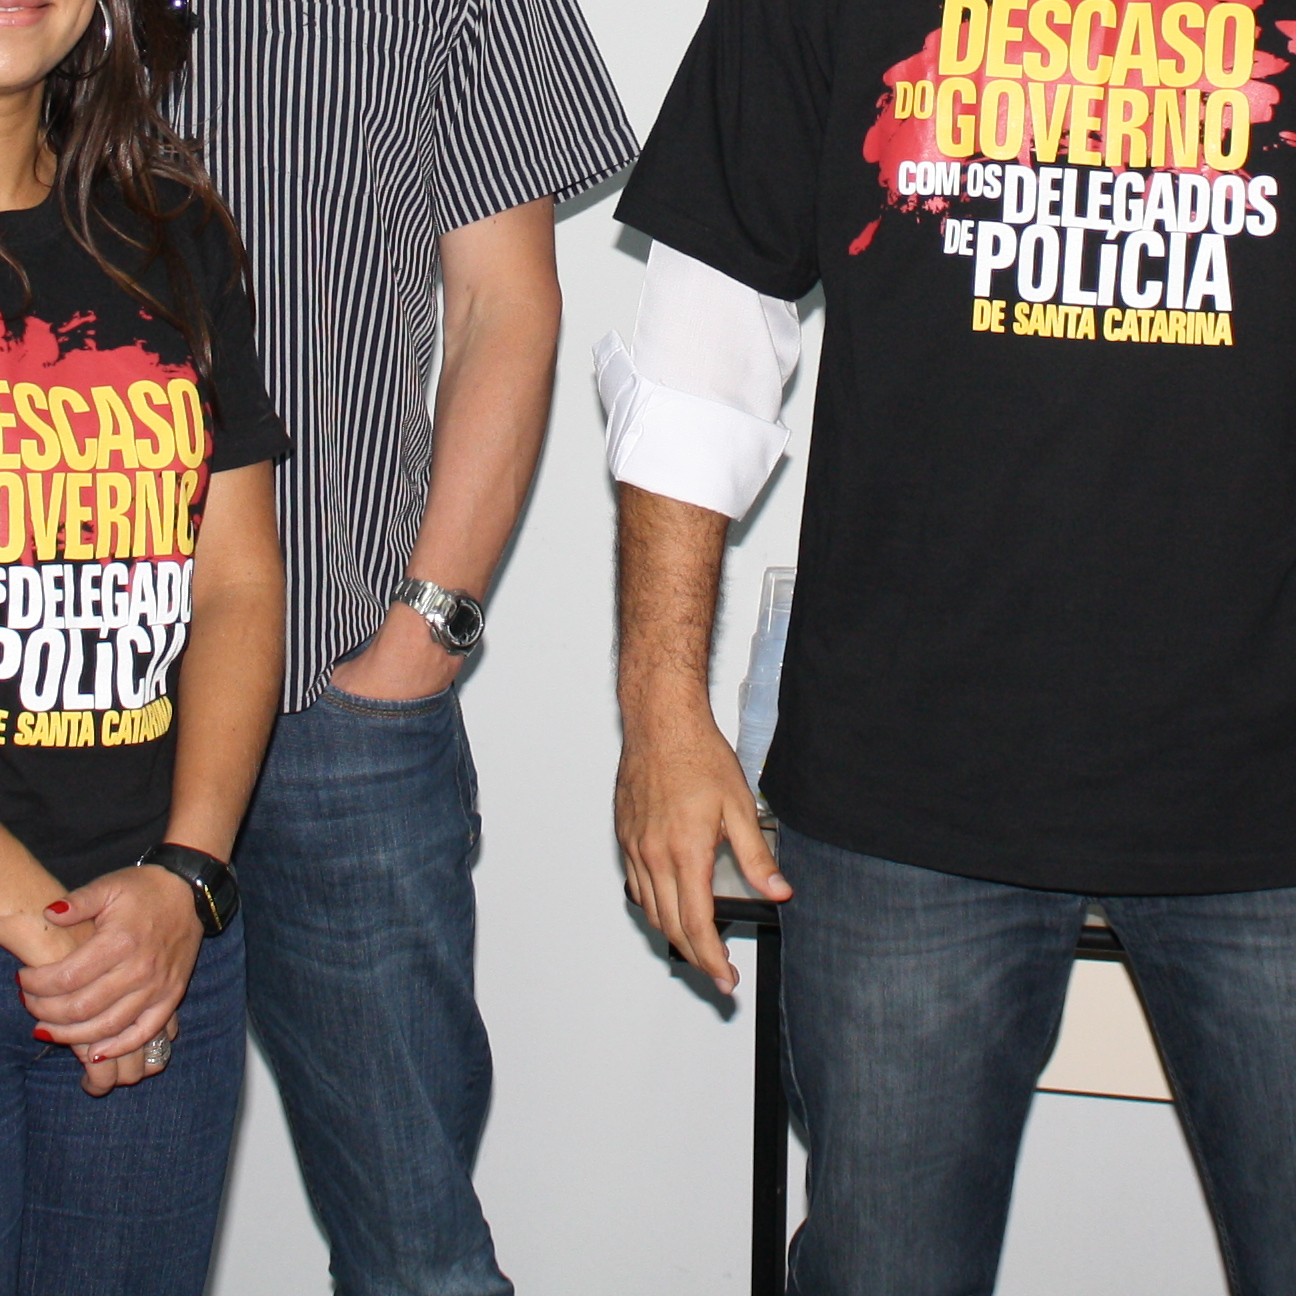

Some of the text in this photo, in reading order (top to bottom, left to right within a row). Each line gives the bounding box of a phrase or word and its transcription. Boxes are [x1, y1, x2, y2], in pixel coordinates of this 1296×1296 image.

[894, 77, 1251, 171] DO GOVERNO
[897, 160, 1278, 236] COM OS DELEGADOS
[943, 218, 1233, 311] DE POLÍCIA
[972, 298, 1233, 346] DE SANTA CATARINA
[7, 559, 194, 630] DELEGADO
[13, 710, 95, 748] SANTA
